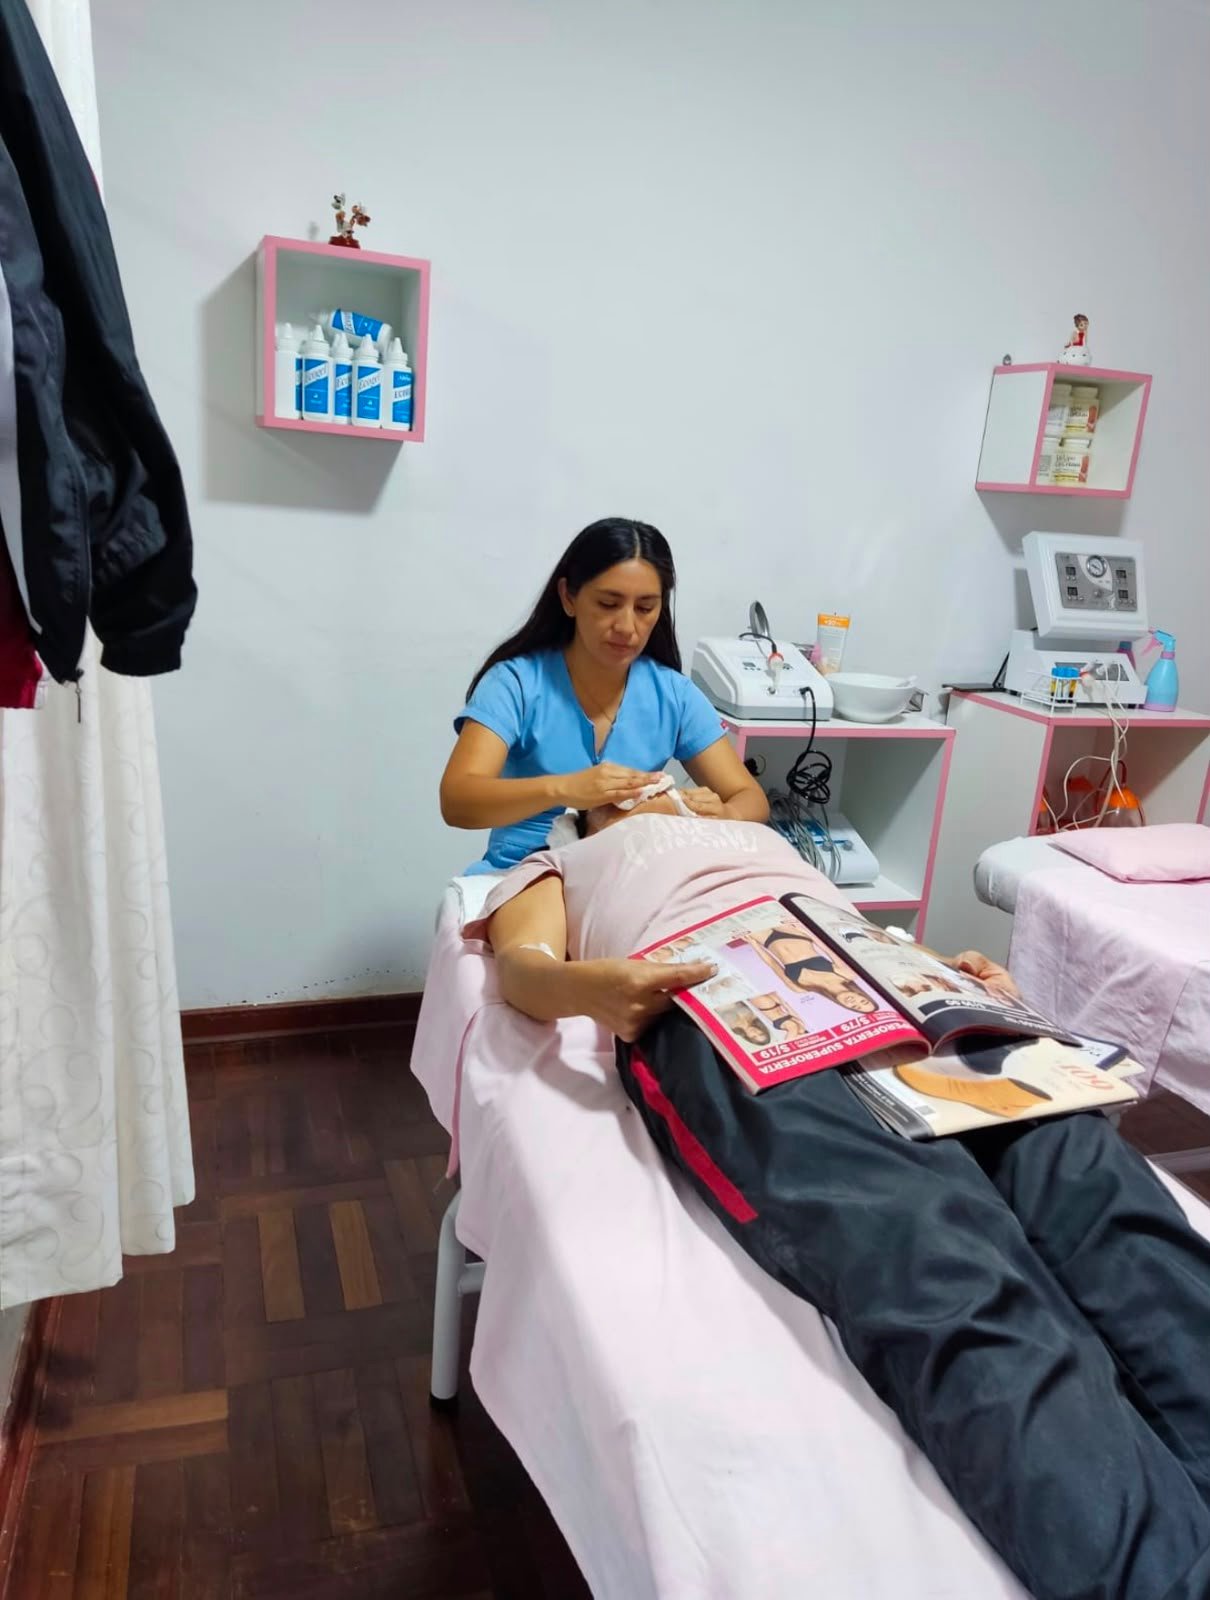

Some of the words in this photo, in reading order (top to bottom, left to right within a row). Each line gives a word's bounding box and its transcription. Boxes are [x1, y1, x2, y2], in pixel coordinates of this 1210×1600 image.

[841, 1016, 871, 1032] S/79
[844, 1021, 914, 1046] PEROFERTA
[758, 1043, 844, 1074] SUPEROFERTA
[760, 1043, 791, 1059] S/19
